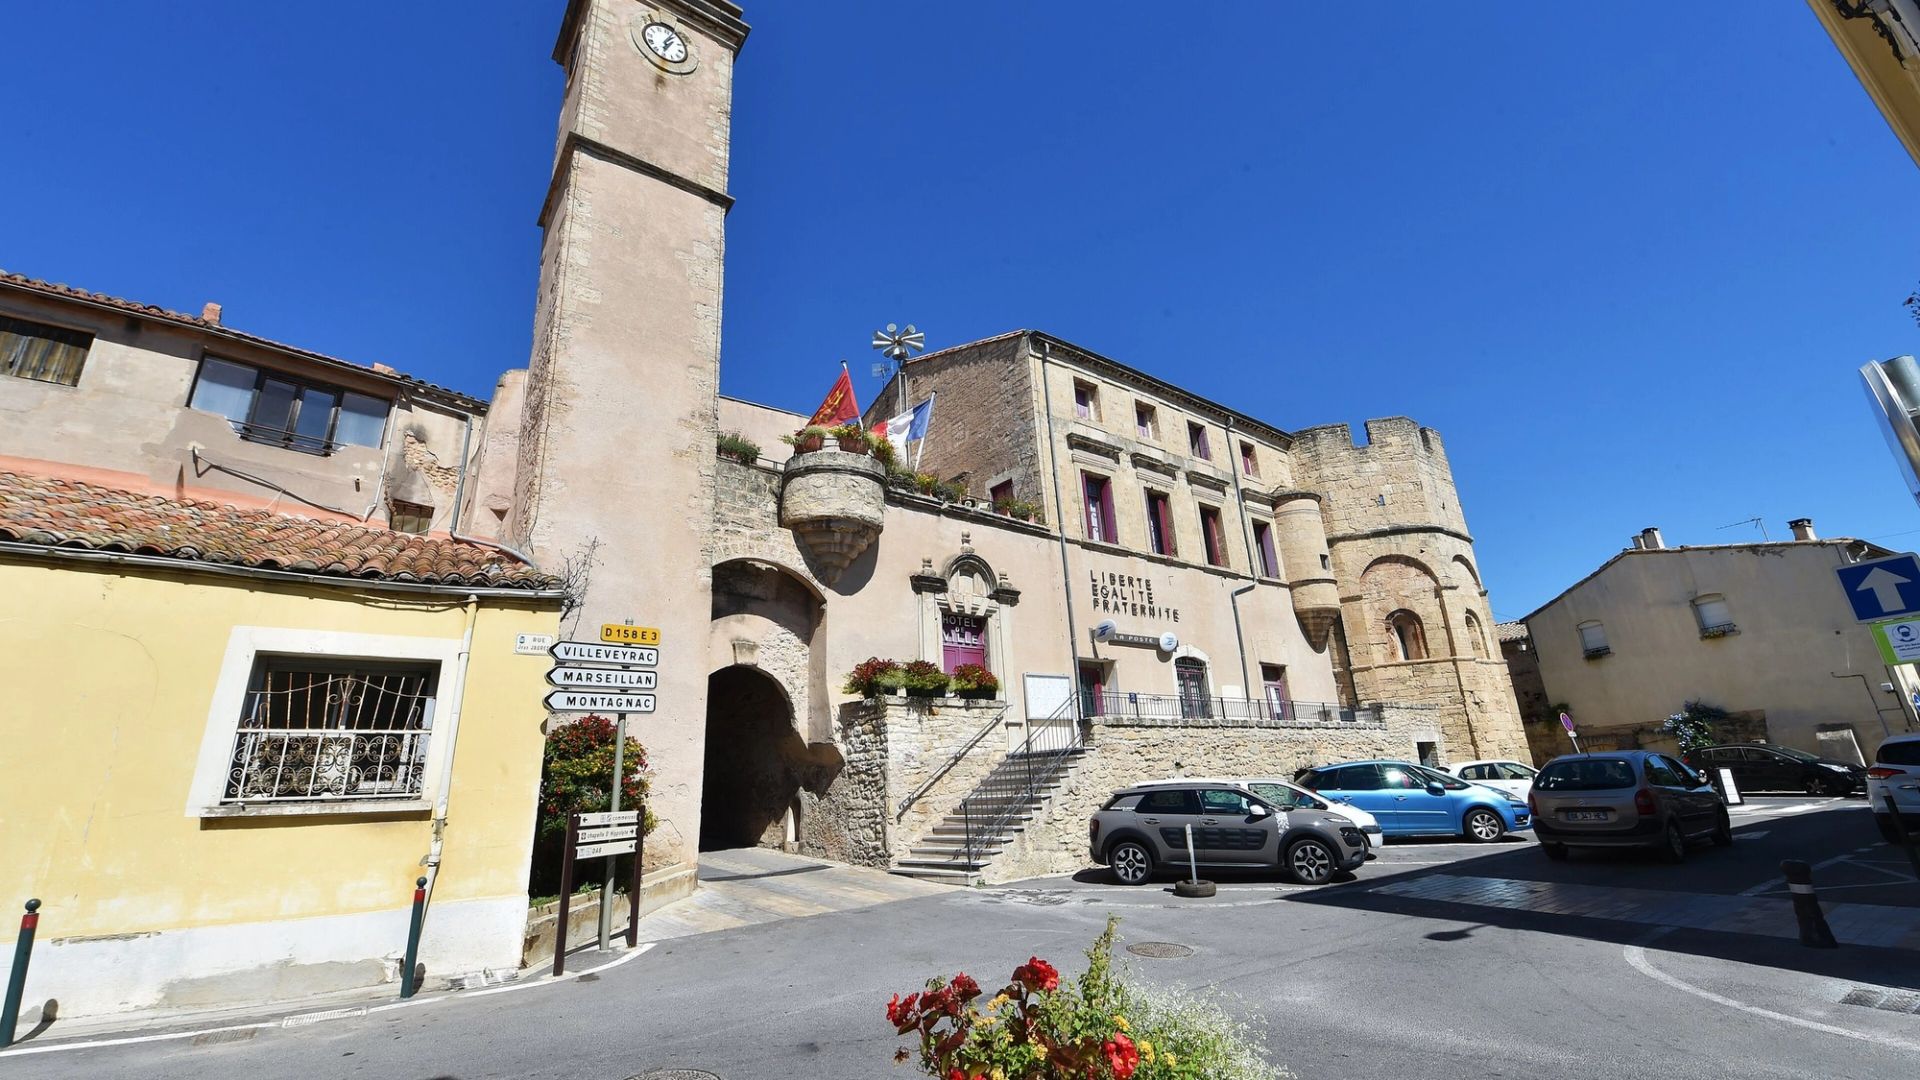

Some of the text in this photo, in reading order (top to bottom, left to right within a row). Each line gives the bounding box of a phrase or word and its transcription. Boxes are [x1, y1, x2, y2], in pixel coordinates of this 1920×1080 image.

[1090, 570, 1152, 591] LIBERTE
[1092, 584, 1153, 605] EGALITE
[1093, 598, 1180, 623] FRATERNITE
[942, 615, 977, 628] HOTEL
[942, 631, 979, 645] VILLE
[1129, 635, 1154, 643] POSTE
[564, 646, 653, 662] VILLEVEYRAC
[563, 671, 652, 685] MARSEILLAN
[566, 696, 651, 709] MONTAGNAC
